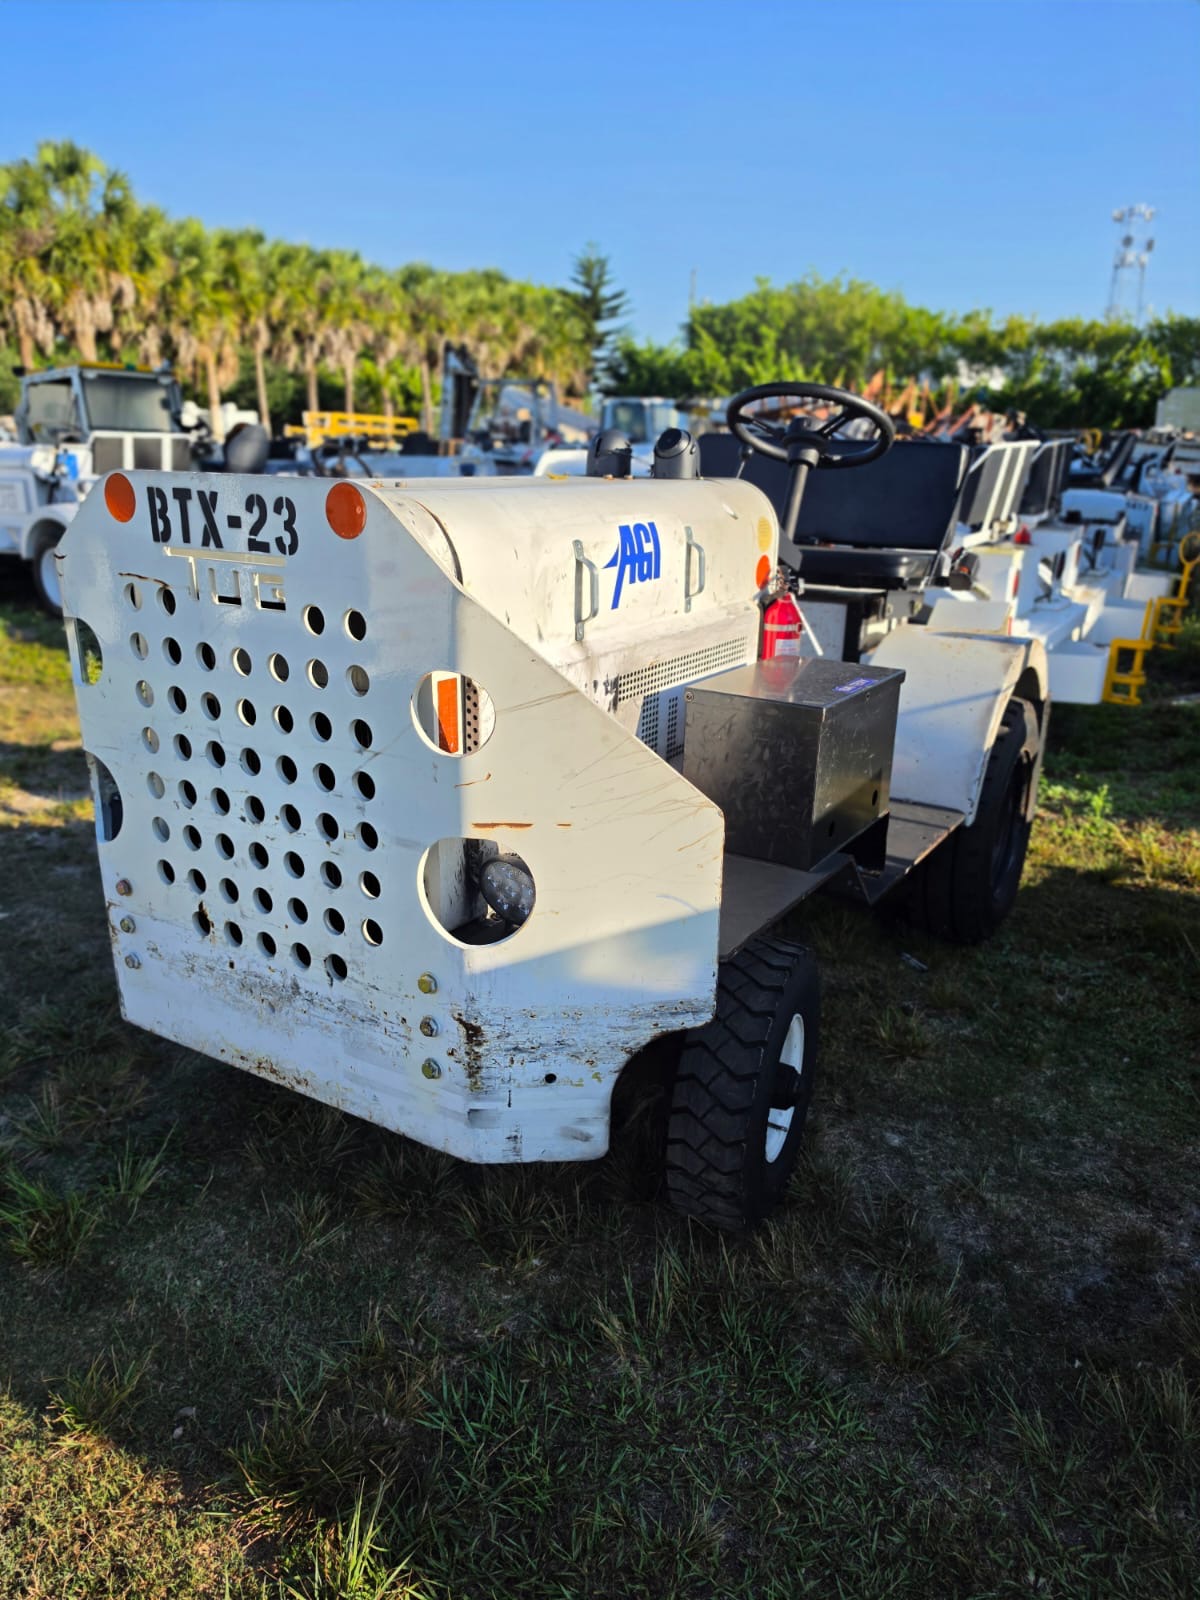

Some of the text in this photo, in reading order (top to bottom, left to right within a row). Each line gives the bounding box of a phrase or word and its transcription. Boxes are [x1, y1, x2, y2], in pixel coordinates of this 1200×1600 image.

[146, 486, 299, 556] BTX-23
[163, 546, 287, 612] TUG
[603, 521, 661, 609] AGI
